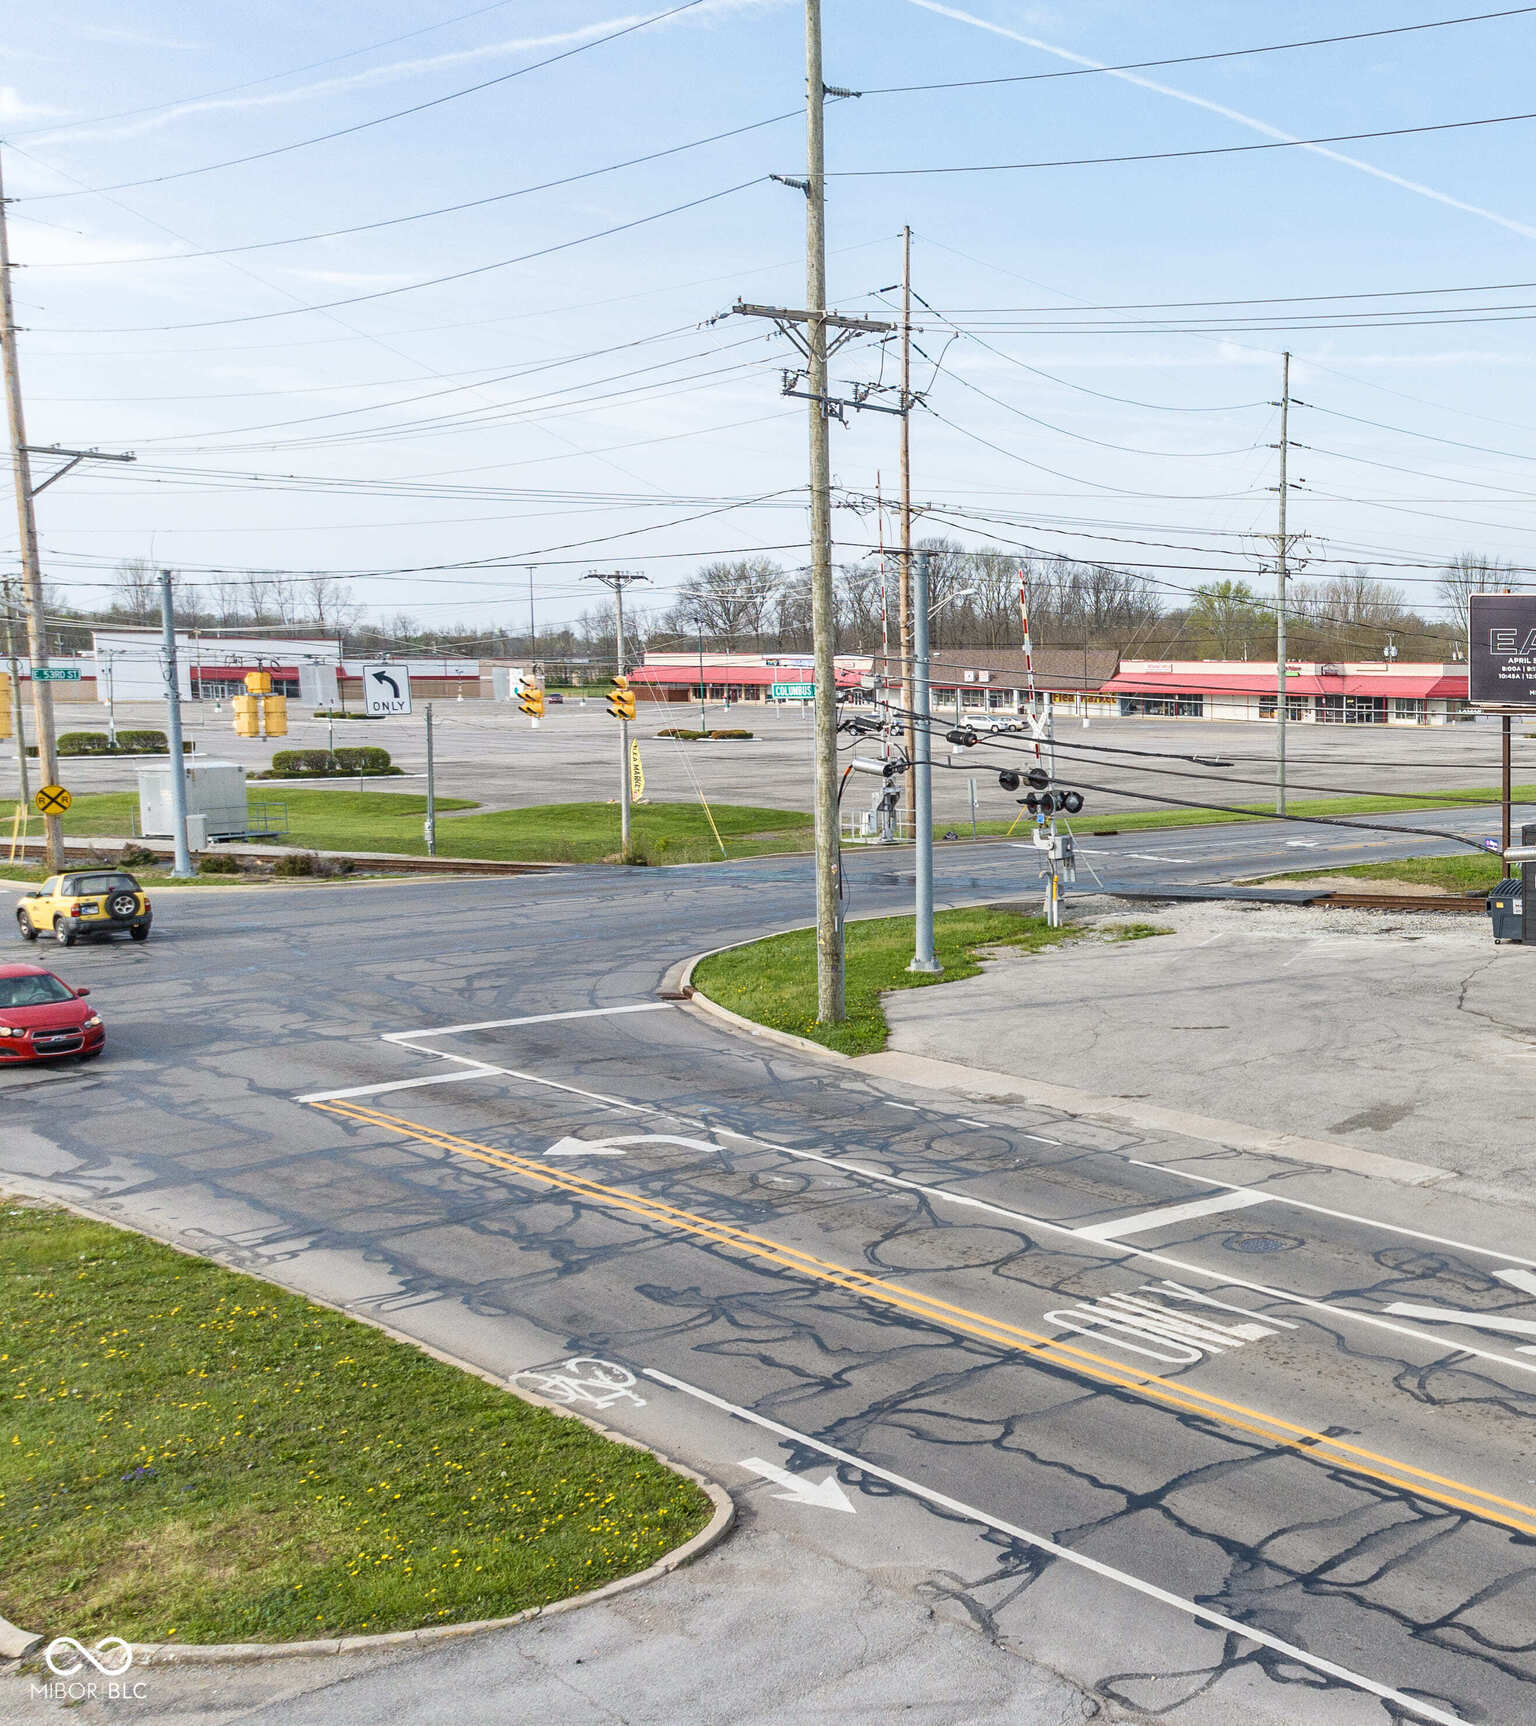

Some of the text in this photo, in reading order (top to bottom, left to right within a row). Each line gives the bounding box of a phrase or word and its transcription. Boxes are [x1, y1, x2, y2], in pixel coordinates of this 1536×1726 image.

[34, 670, 40, 679] E
[45, 670, 65, 679] 53RD
[775, 686, 811, 697] COLUMBUS
[373, 701, 405, 711] ONLY
[1043, 1280, 1300, 1363] ONLY
